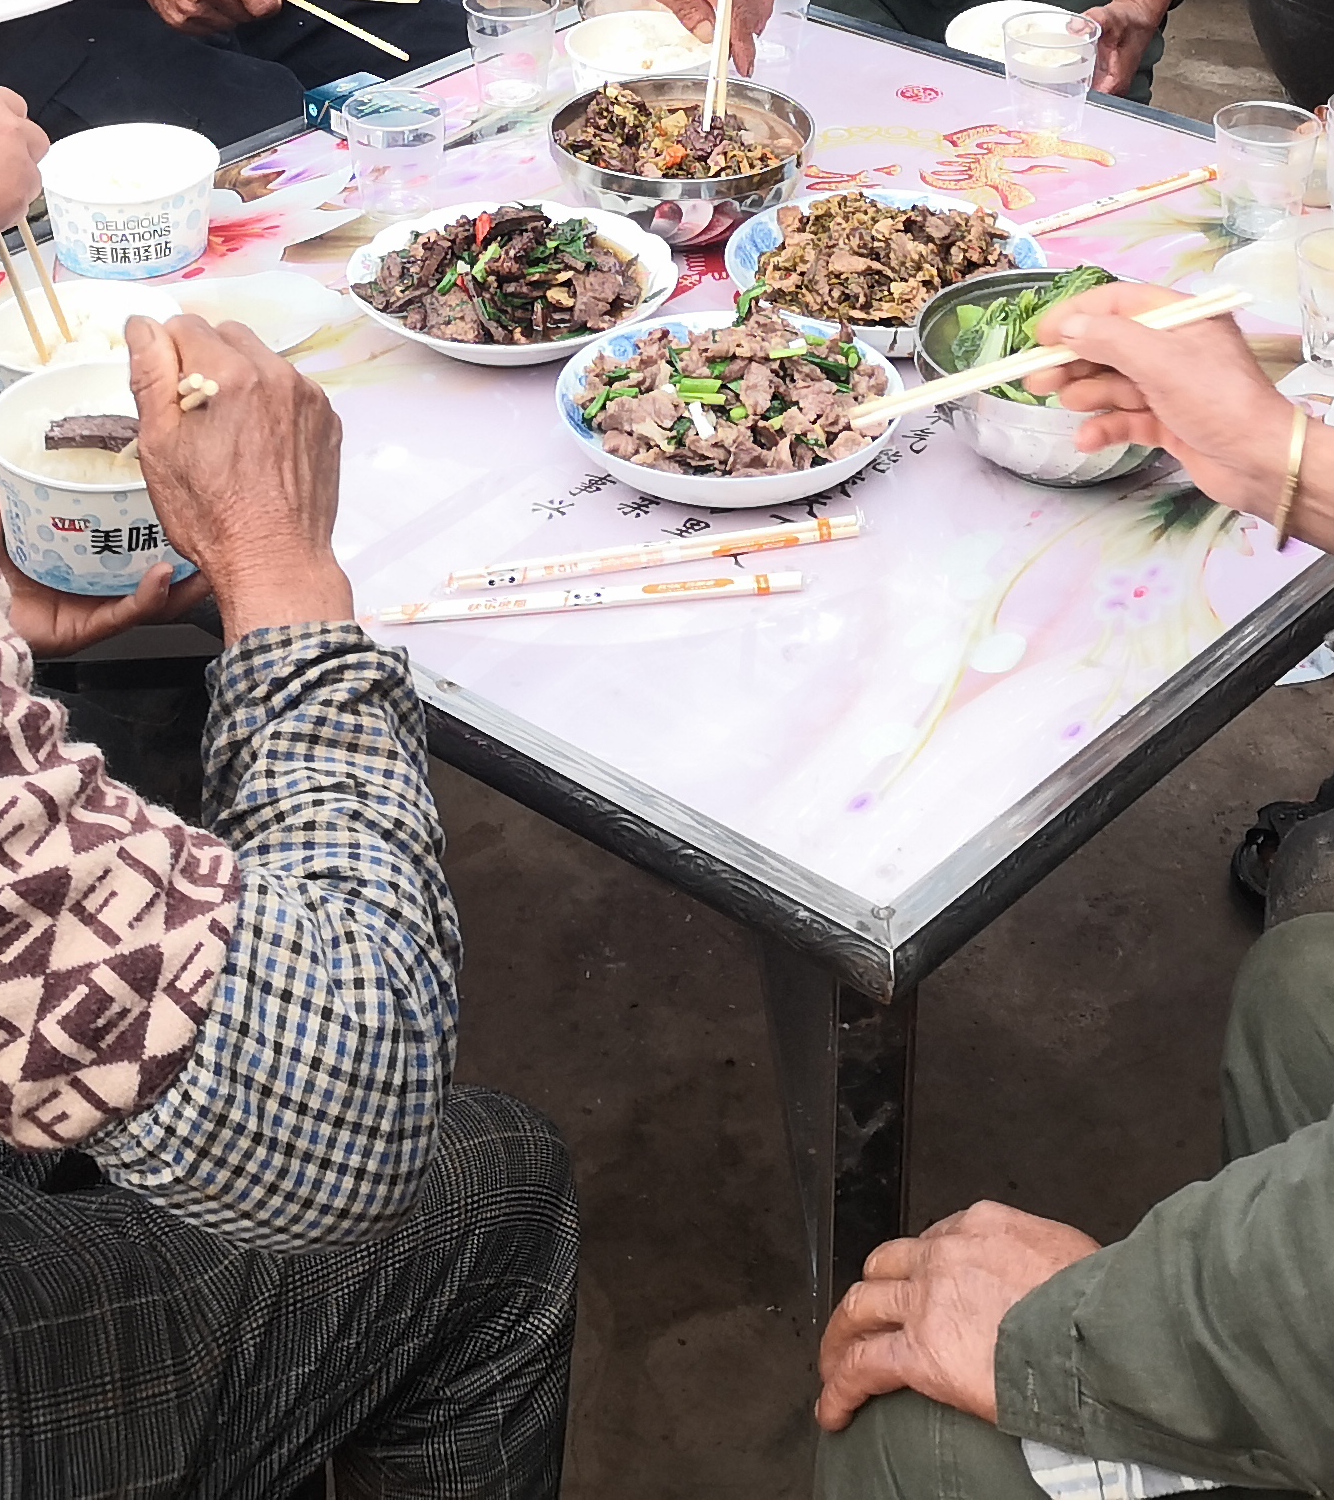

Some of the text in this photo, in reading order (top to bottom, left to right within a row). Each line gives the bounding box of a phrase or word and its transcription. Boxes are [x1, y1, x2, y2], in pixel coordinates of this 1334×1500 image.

[95, 212, 170, 231] DELICIOUS
[91, 225, 171, 244] LOCATIONS
[89, 240, 172, 264] 美味驿站
[51, 516, 91, 533] NEW
[90, 523, 173, 556] 美味
